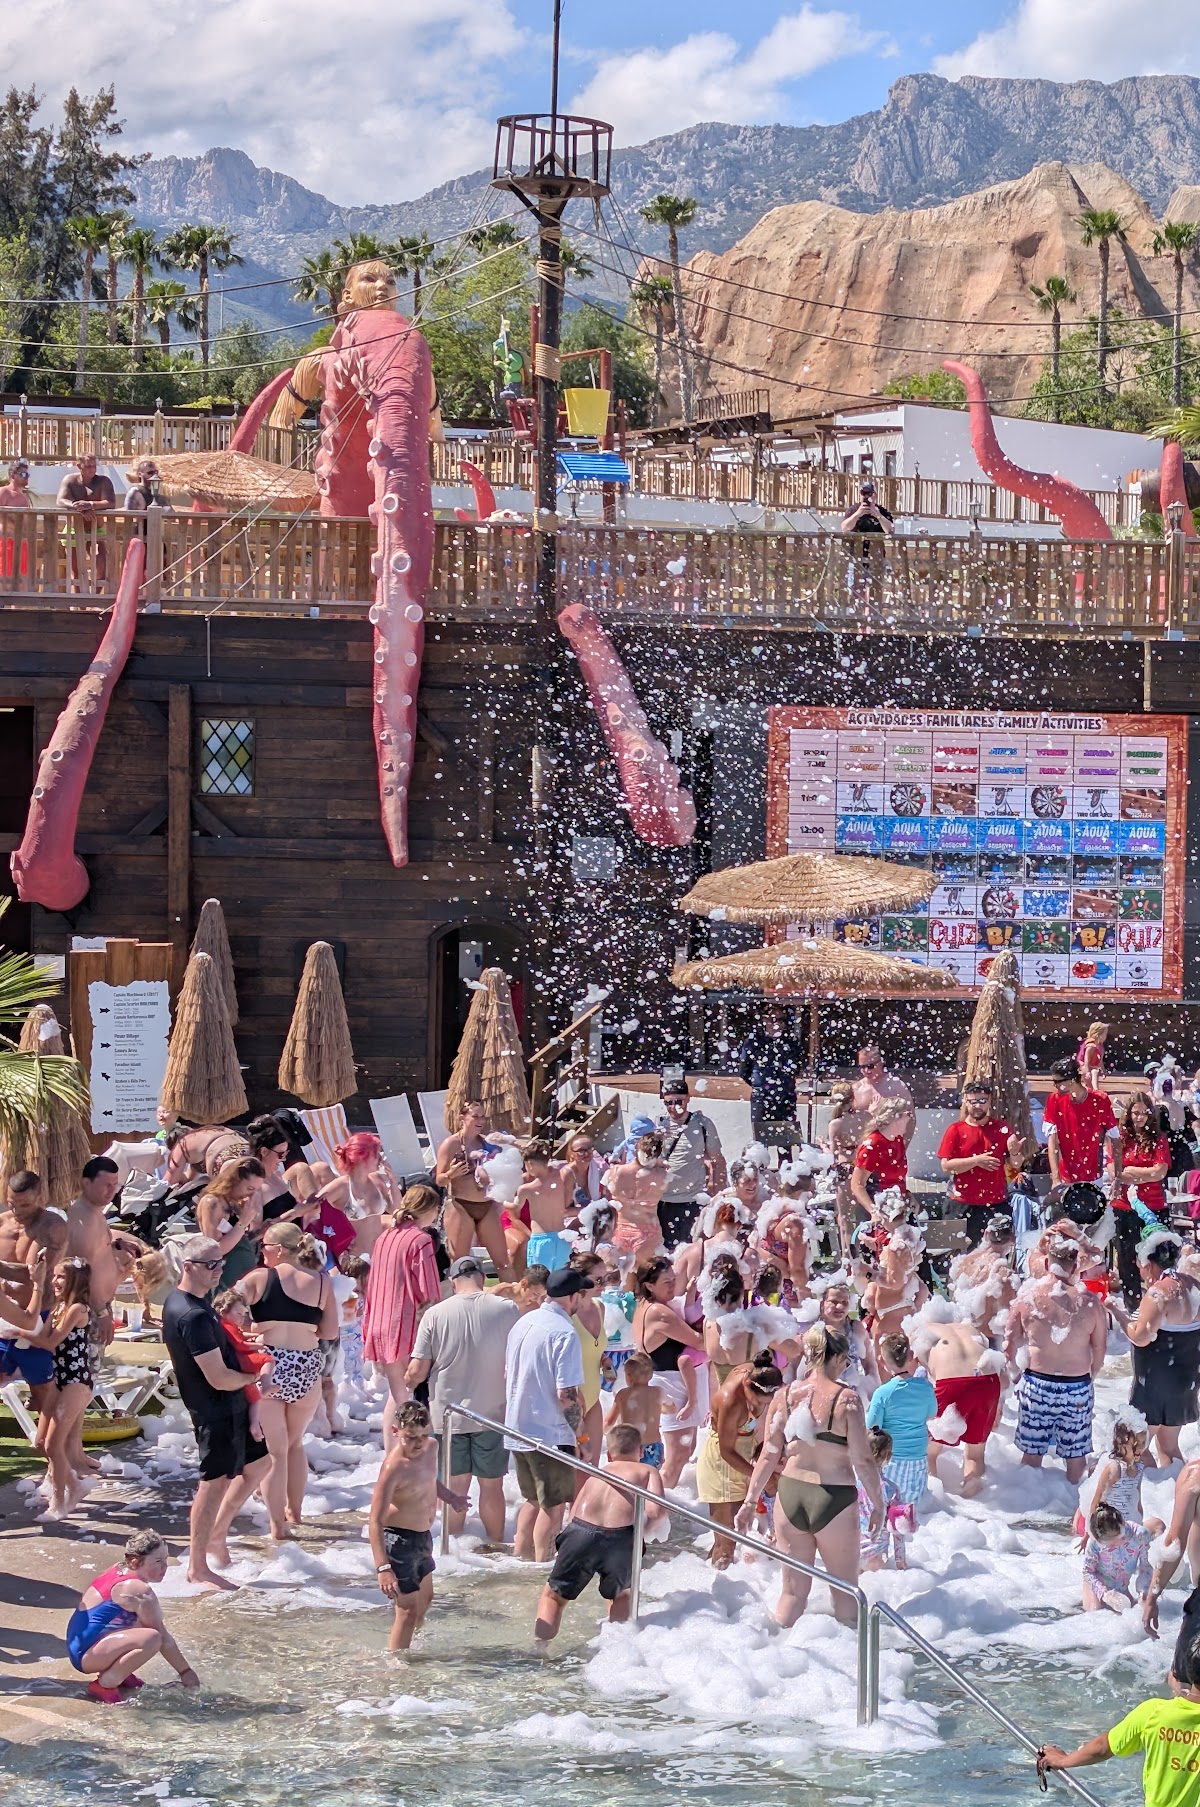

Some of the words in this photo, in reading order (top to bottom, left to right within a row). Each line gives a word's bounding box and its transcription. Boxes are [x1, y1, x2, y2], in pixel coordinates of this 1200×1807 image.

[848, 712, 923, 726] ACTIVIDADES
[926, 713, 994, 728] FAMILIARES
[998, 716, 1039, 729] FAMILY
[1042, 717, 1102, 731] ACTIVITIES
[800, 825, 825, 834] 12:00
[988, 825, 1016, 836] AQUA
[1082, 826, 1110, 838] AQUA
[1130, 827, 1157, 839] AQUA
[929, 919, 978, 951] QUIZ
[986, 925, 1014, 946] B!
[1080, 927, 1107, 947] B!
[1118, 923, 1163, 953] QUIZ
